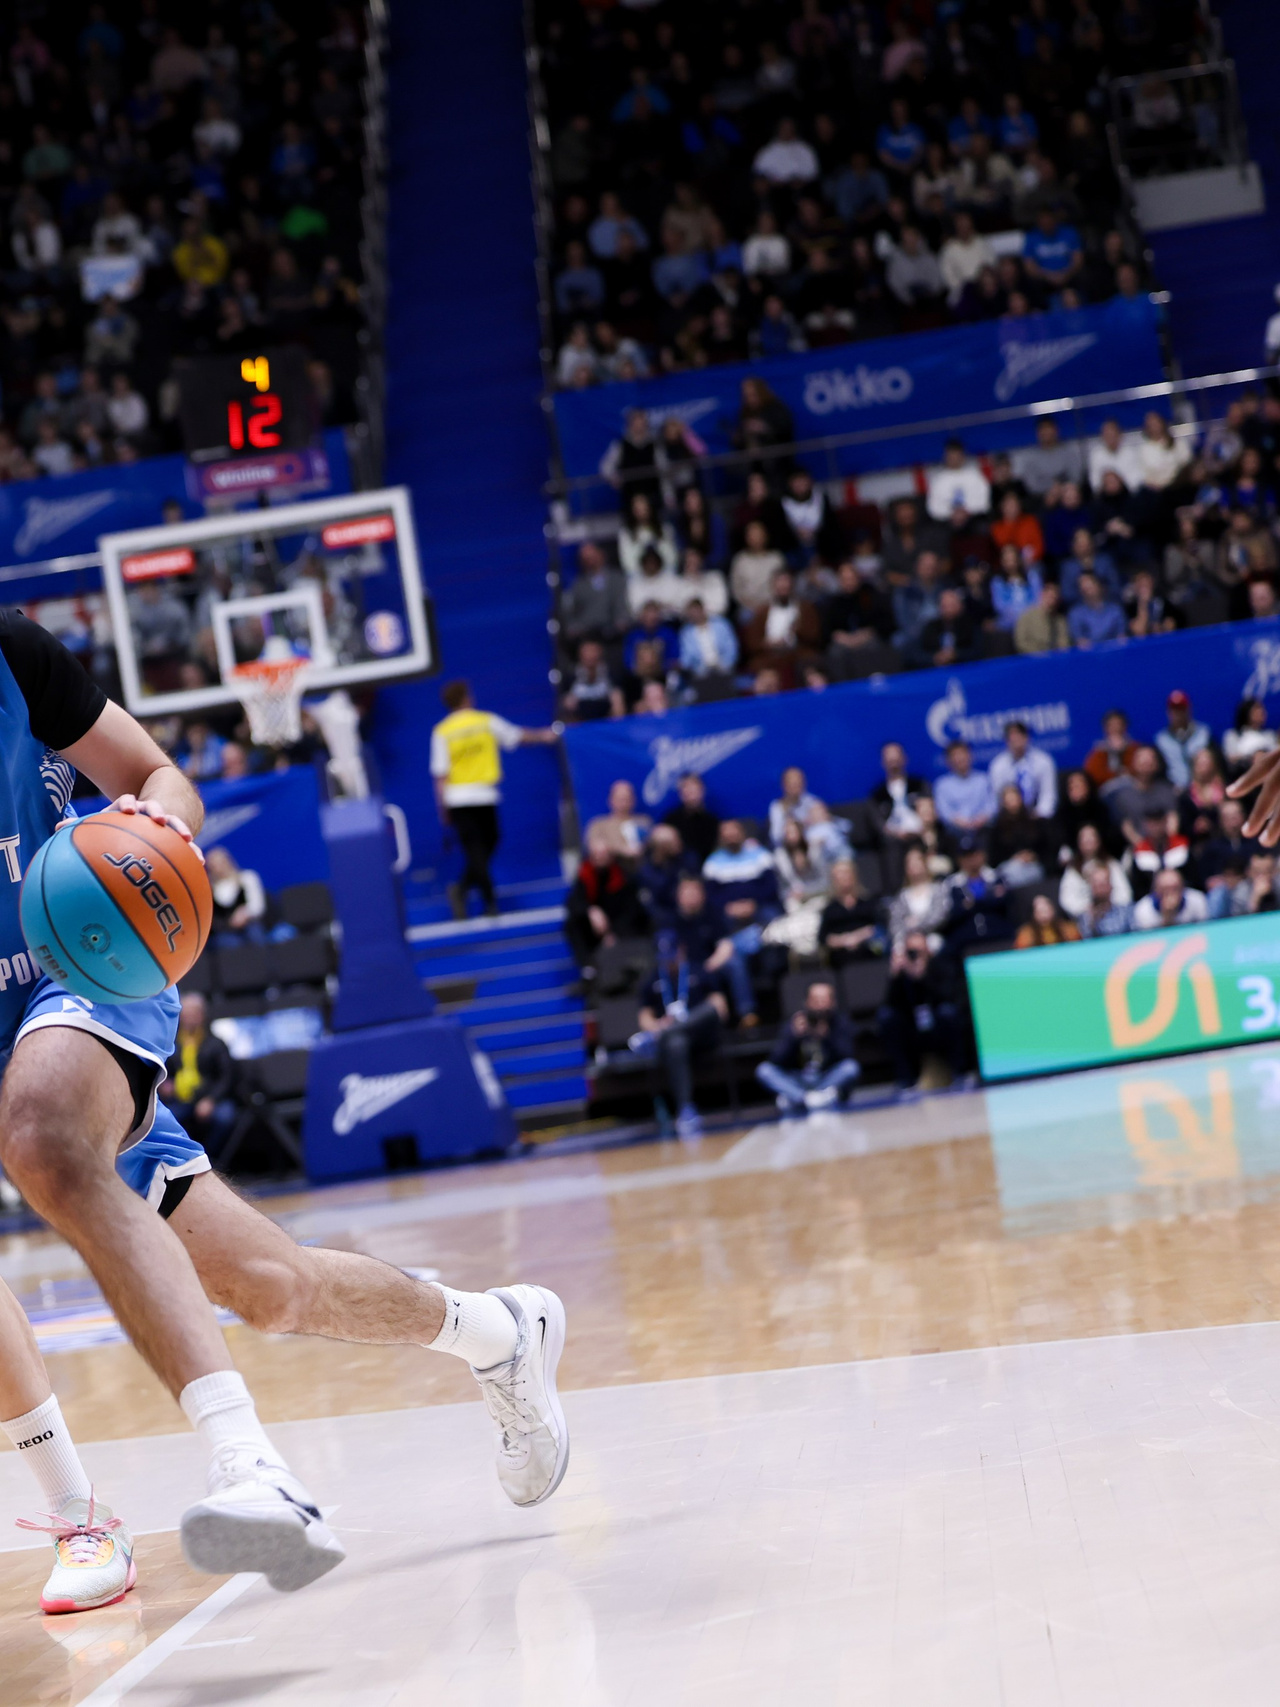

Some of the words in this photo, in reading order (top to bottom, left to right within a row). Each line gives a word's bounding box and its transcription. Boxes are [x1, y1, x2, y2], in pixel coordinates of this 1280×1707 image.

[241, 355, 270, 393] 4
[227, 393, 283, 450] 12
[101, 852, 183, 953] JÖGEL
[36, 944, 69, 980] FIBA
